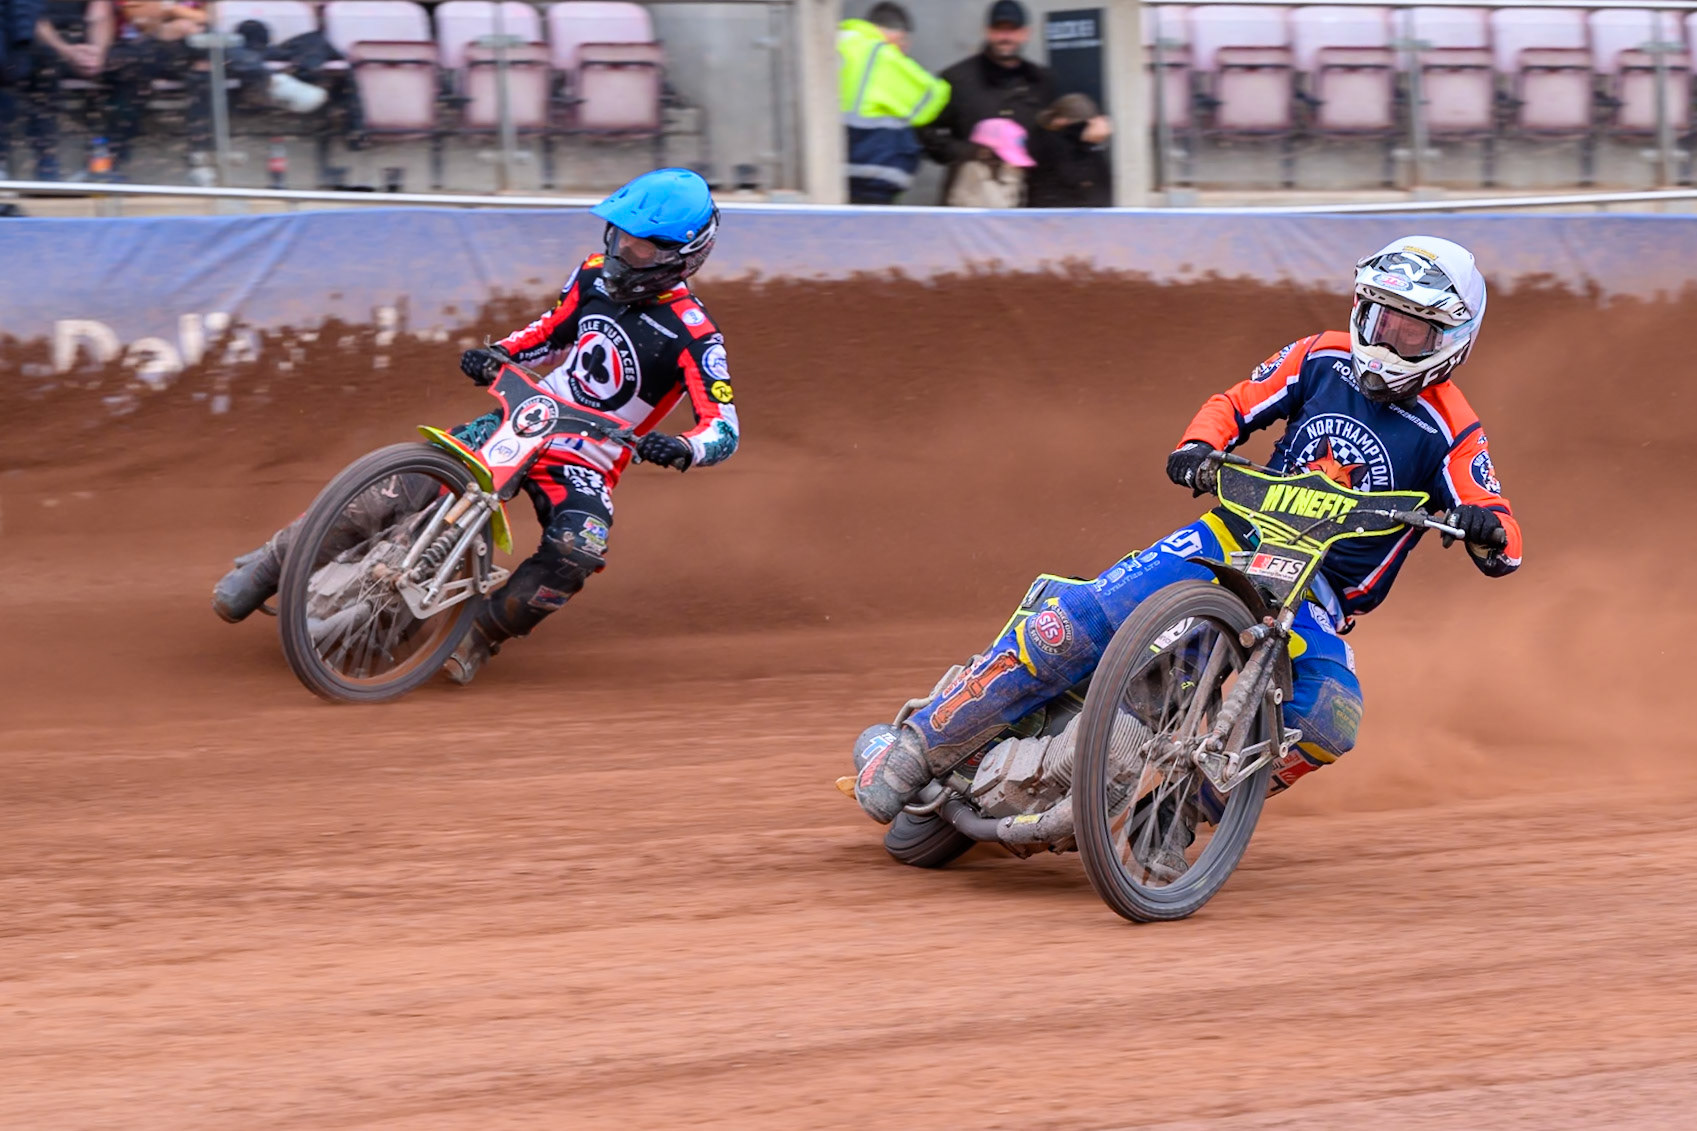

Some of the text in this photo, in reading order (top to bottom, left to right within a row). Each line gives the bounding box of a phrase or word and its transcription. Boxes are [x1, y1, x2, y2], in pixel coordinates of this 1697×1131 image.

[603, 323, 624, 346] VUE
[619, 349, 636, 382] ACES
[1306, 418, 1389, 487] NORTHAMPTON
[1260, 484, 1359, 525] MYNEFIT
[1144, 560, 1161, 572] LTD
[1267, 557, 1303, 575] FTS
[1038, 614, 1061, 640] STS
